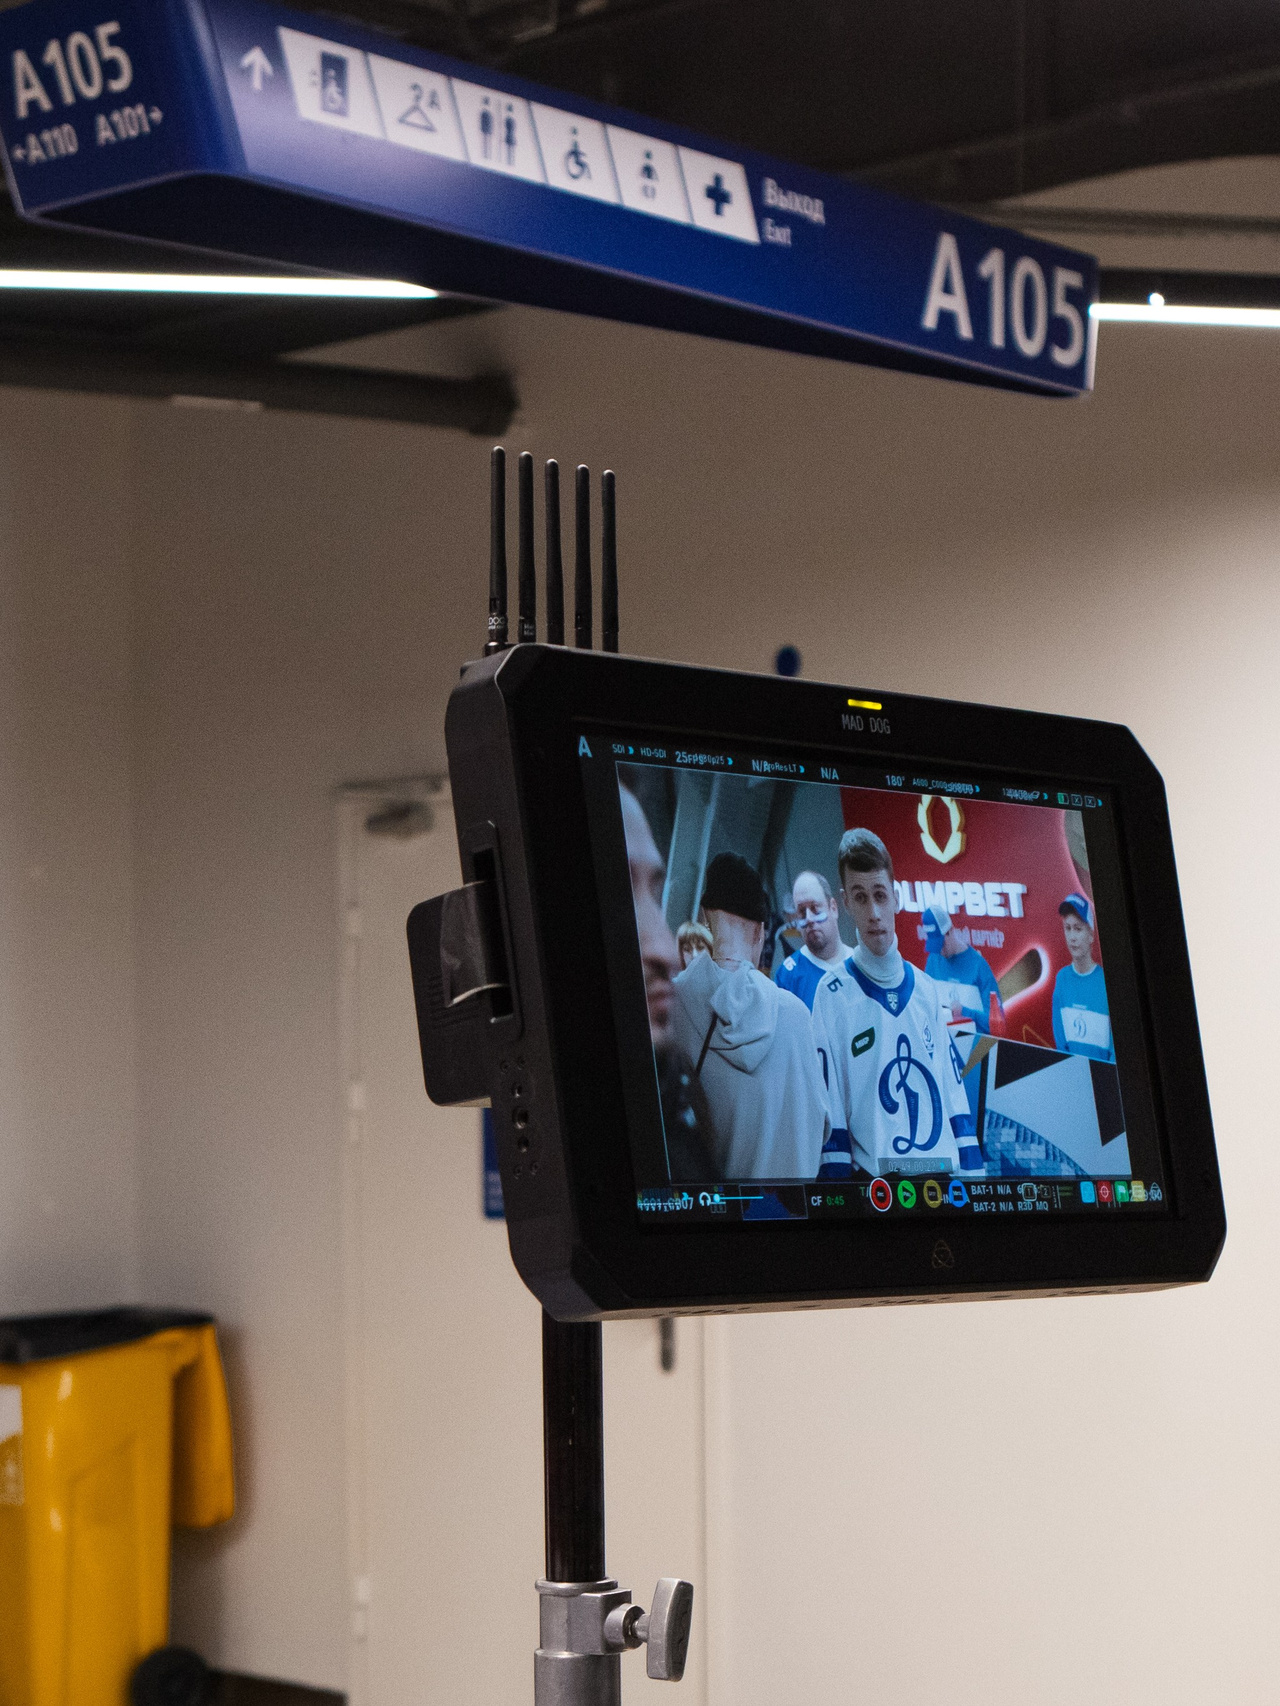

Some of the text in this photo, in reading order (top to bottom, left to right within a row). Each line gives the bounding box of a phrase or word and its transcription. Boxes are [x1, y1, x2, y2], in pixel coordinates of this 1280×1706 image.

[12, 20, 133, 119] A105
[921, 231, 1085, 369] A105
[841, 713, 891, 734] MAD DOG
[578, 735, 592, 757] A
[820, 766, 840, 781] N/A
[971, 1184, 994, 1195] BAT-1
[997, 1184, 1012, 1195] N/A
[811, 1196, 822, 1206] CF
[973, 1201, 996, 1212] BAT-2
[1000, 1201, 1014, 1212] N/A
